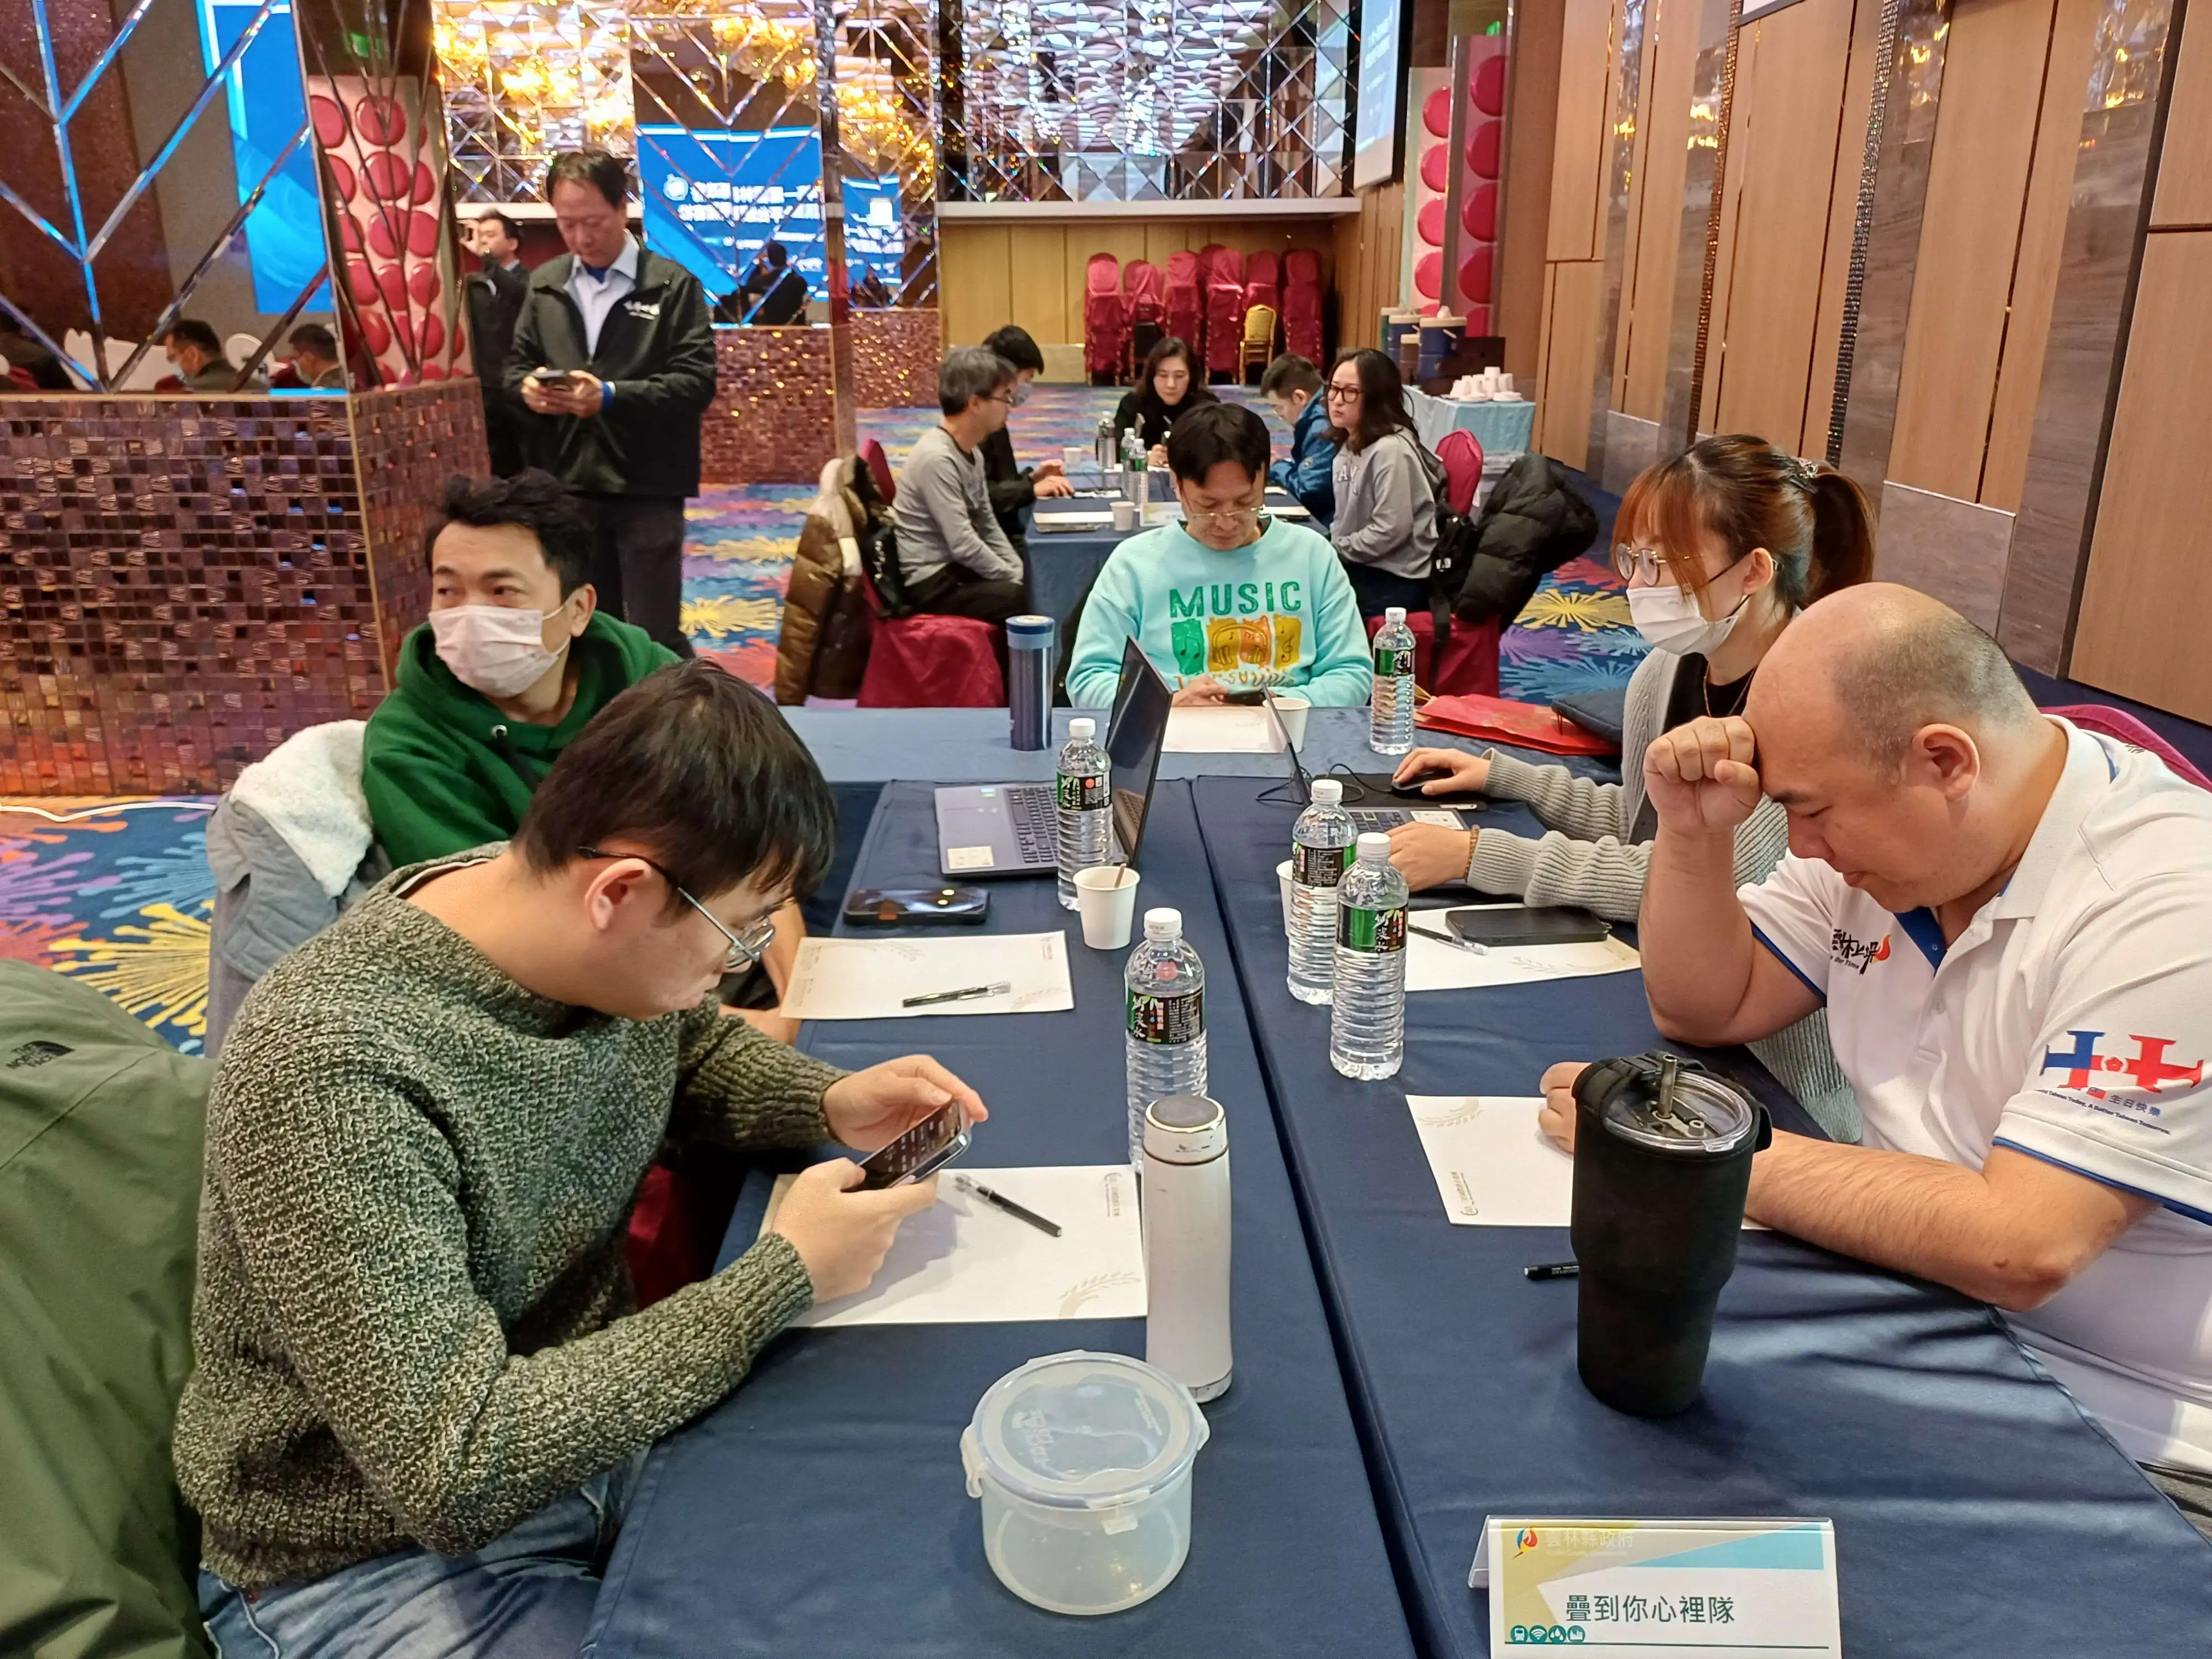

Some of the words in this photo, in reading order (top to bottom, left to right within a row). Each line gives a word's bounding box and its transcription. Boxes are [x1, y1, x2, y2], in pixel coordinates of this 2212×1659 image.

[1170, 581, 1301, 618] MUSIC
[1566, 1594, 1735, 1624] 疊到你心裡隊
